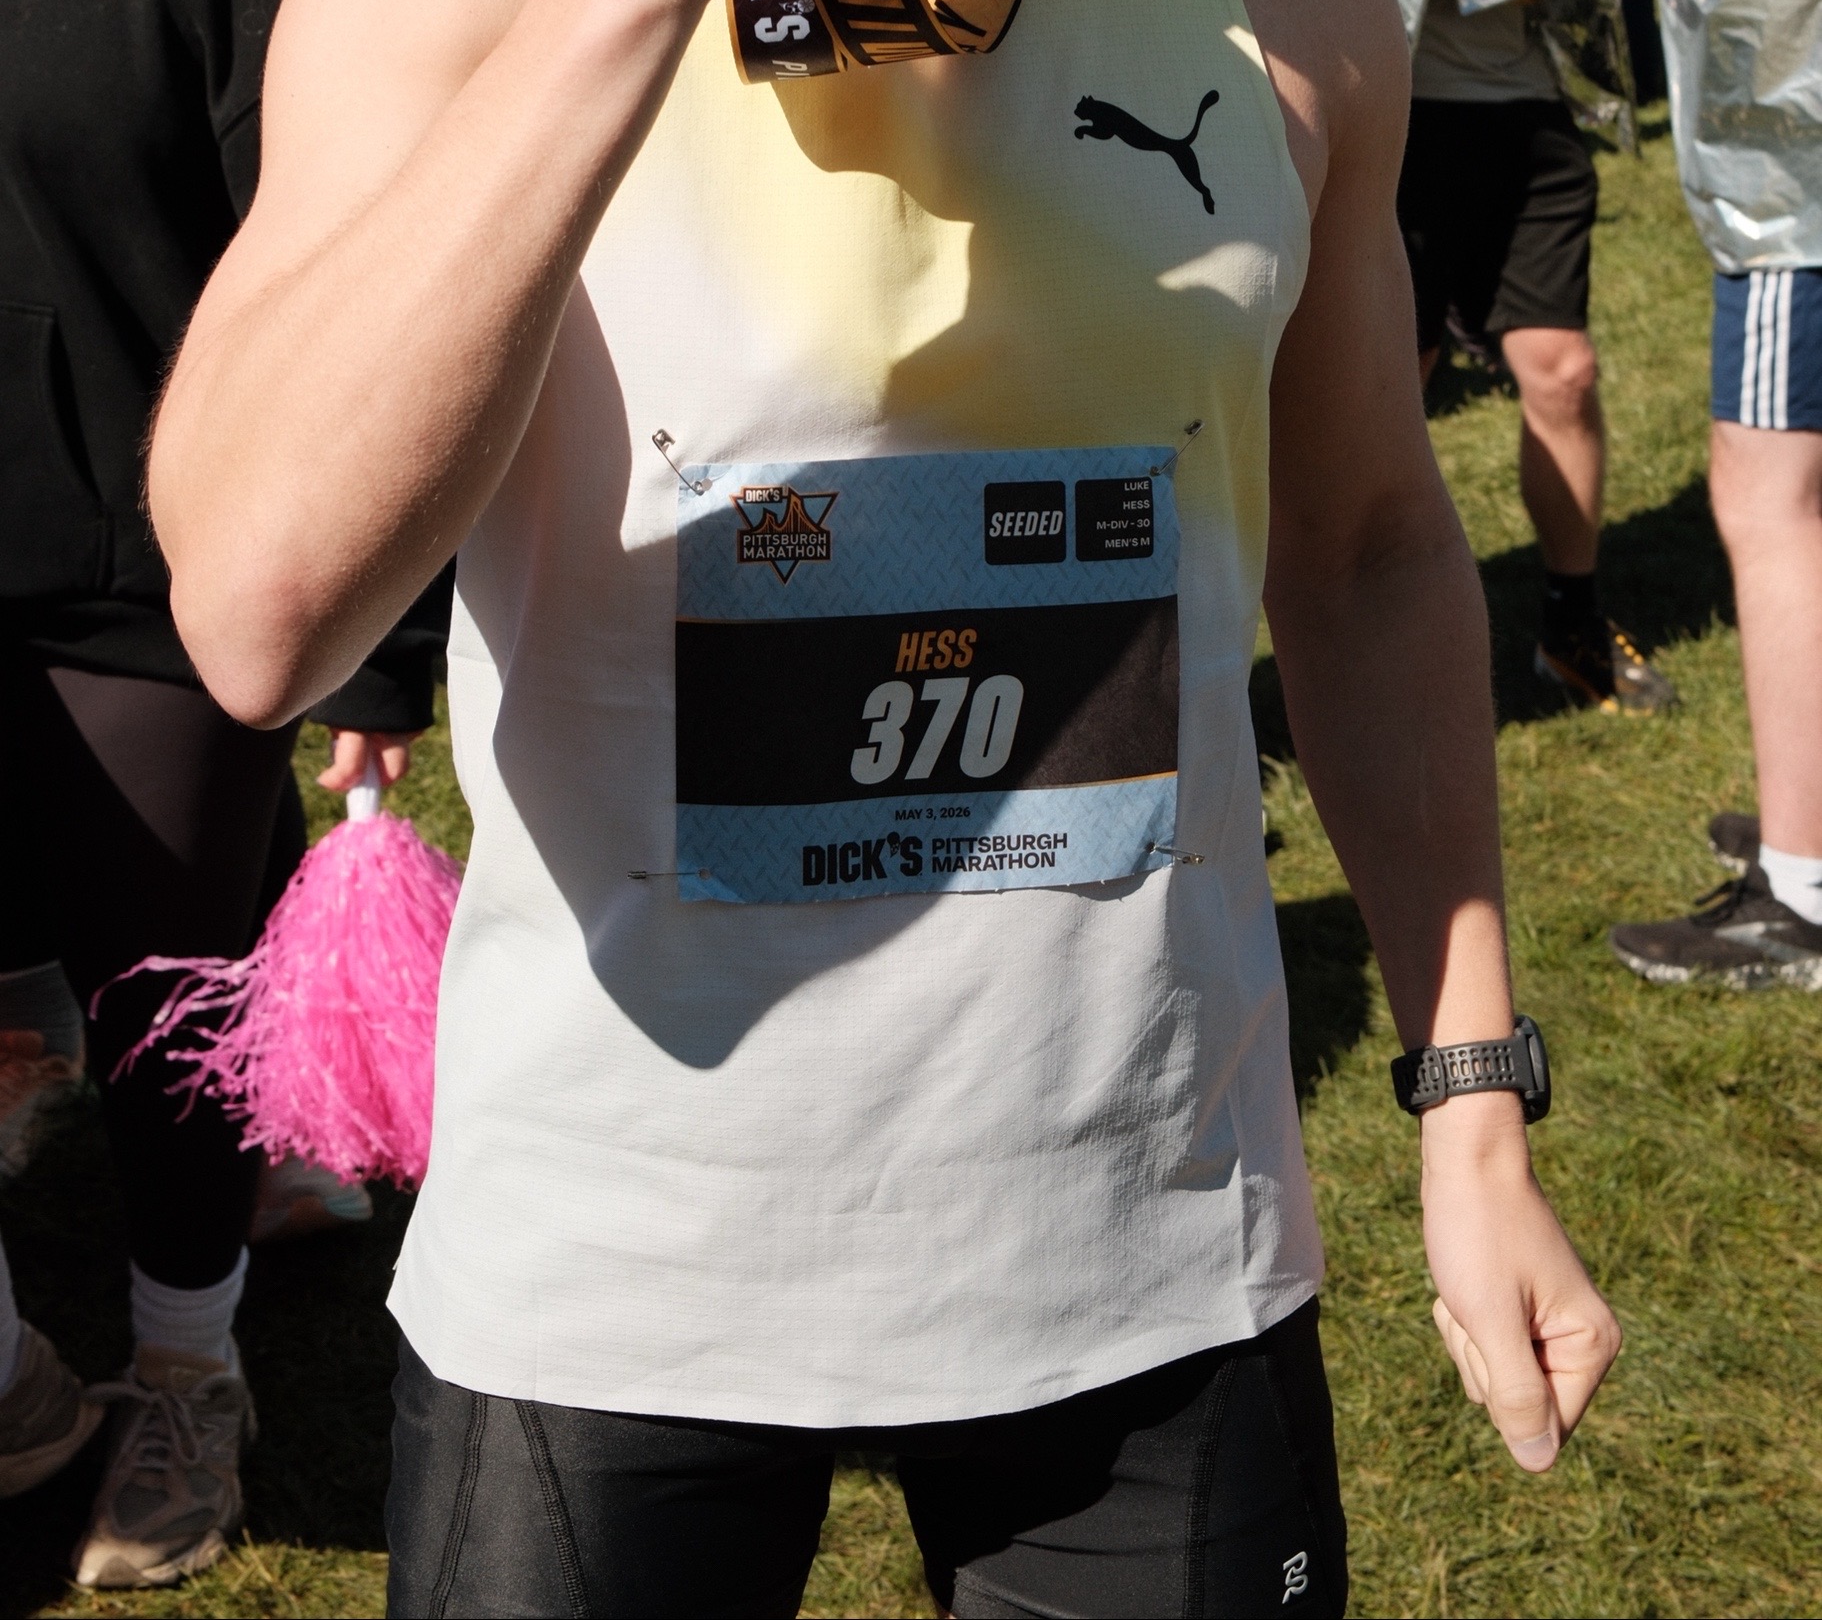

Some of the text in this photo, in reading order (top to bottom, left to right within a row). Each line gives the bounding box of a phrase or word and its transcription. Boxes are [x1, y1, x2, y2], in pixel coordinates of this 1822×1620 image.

[1124, 480, 1150, 491] LUKE
[744, 488, 781, 503] DICK'S
[1122, 499, 1151, 510] HESS
[989, 510, 1064, 538] SEEDED
[1096, 520, 1129, 530] M-DIV
[1136, 518, 1151, 528] 30
[743, 532, 828, 547] PITTSBURGH
[1104, 536, 1151, 549] MEN'S M
[743, 544, 828, 559] MARATHON
[895, 628, 978, 673] HESS
[850, 674, 1024, 785] 370
[894, 806, 971, 822] MAY 3, 2026
[931, 832, 1068, 855] PITTSBURGH
[802, 831, 923, 886] DICK'S
[931, 851, 1056, 874] MARATHON
